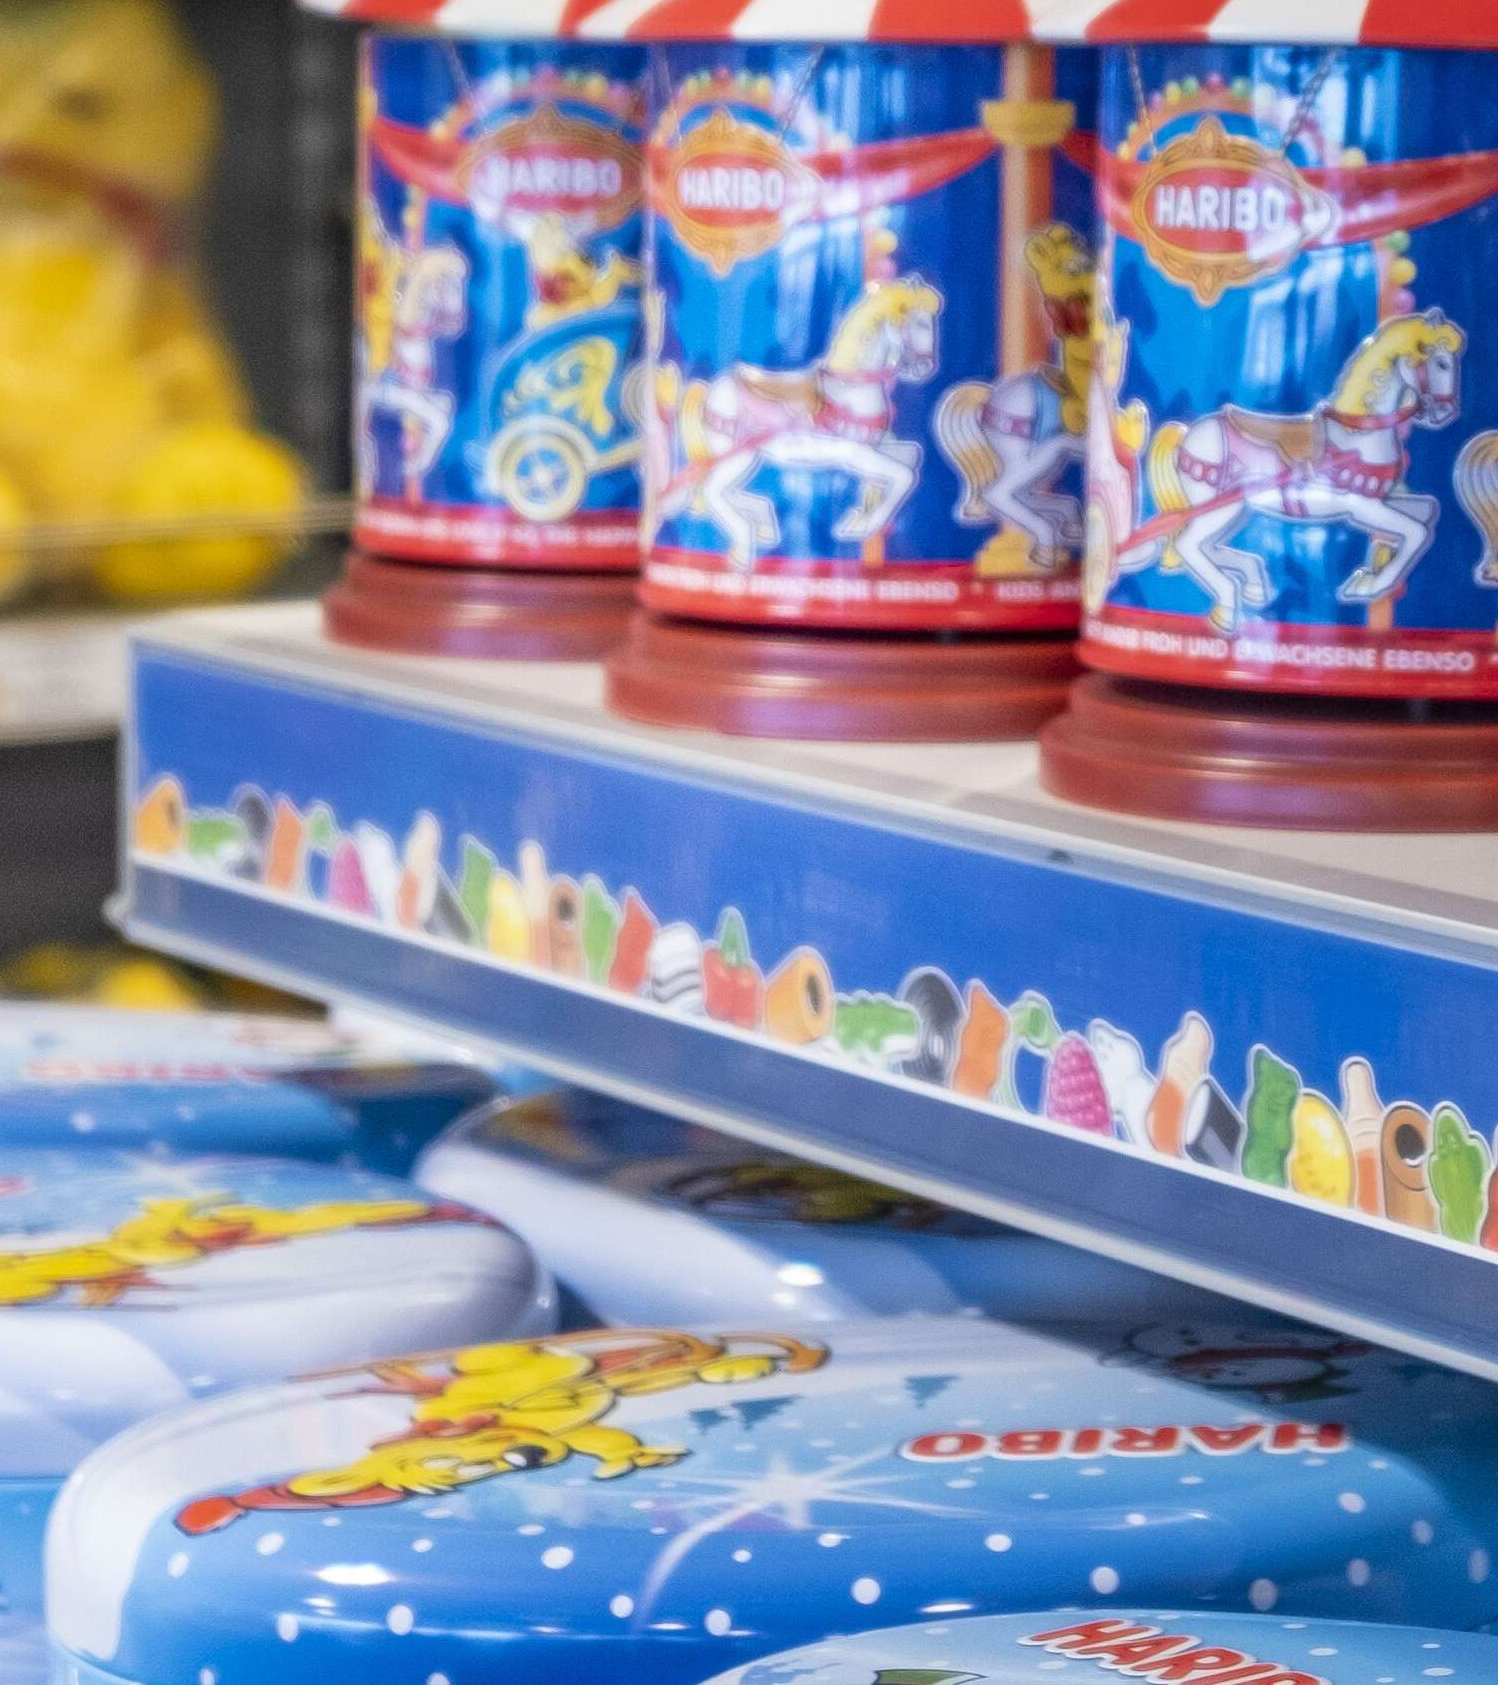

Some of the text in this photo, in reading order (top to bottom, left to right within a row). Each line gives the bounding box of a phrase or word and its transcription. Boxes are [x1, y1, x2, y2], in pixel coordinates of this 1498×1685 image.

[679, 168, 785, 210] HARIBO
[1155, 186, 1288, 231] HARIBO
[1383, 648, 1475, 672] EBENSO
[902, 1422, 1347, 1462] HARIBO
